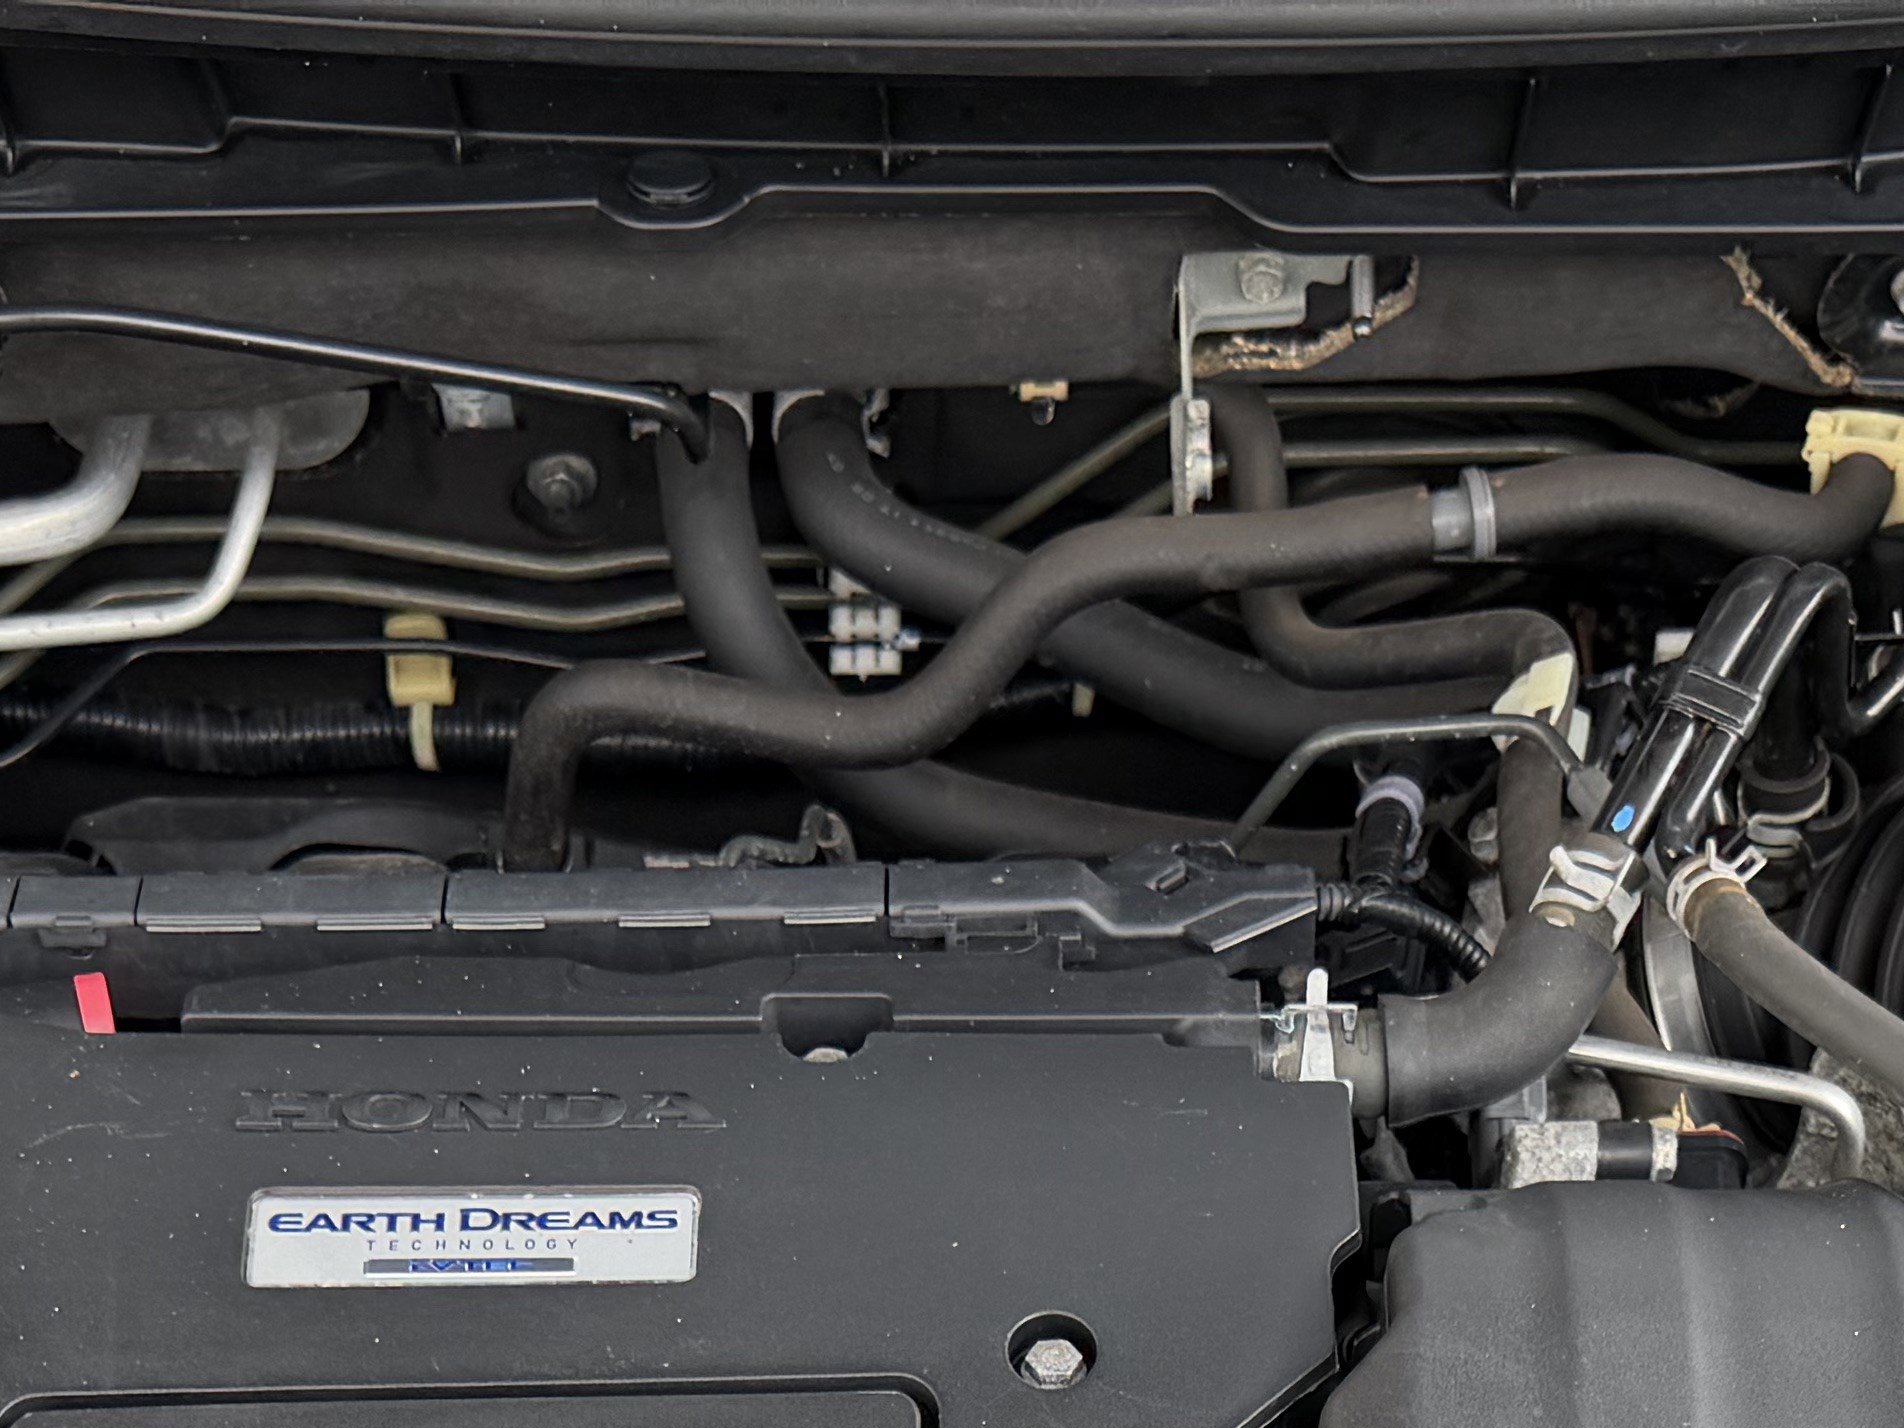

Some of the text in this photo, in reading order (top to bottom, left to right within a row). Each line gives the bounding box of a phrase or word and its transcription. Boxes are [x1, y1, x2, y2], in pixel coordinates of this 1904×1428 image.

[235, 1090, 728, 1133] HONDA
[267, 1208, 678, 1233] EARTH DREAMS
[366, 1238, 579, 1251] TECHNOLOGY
